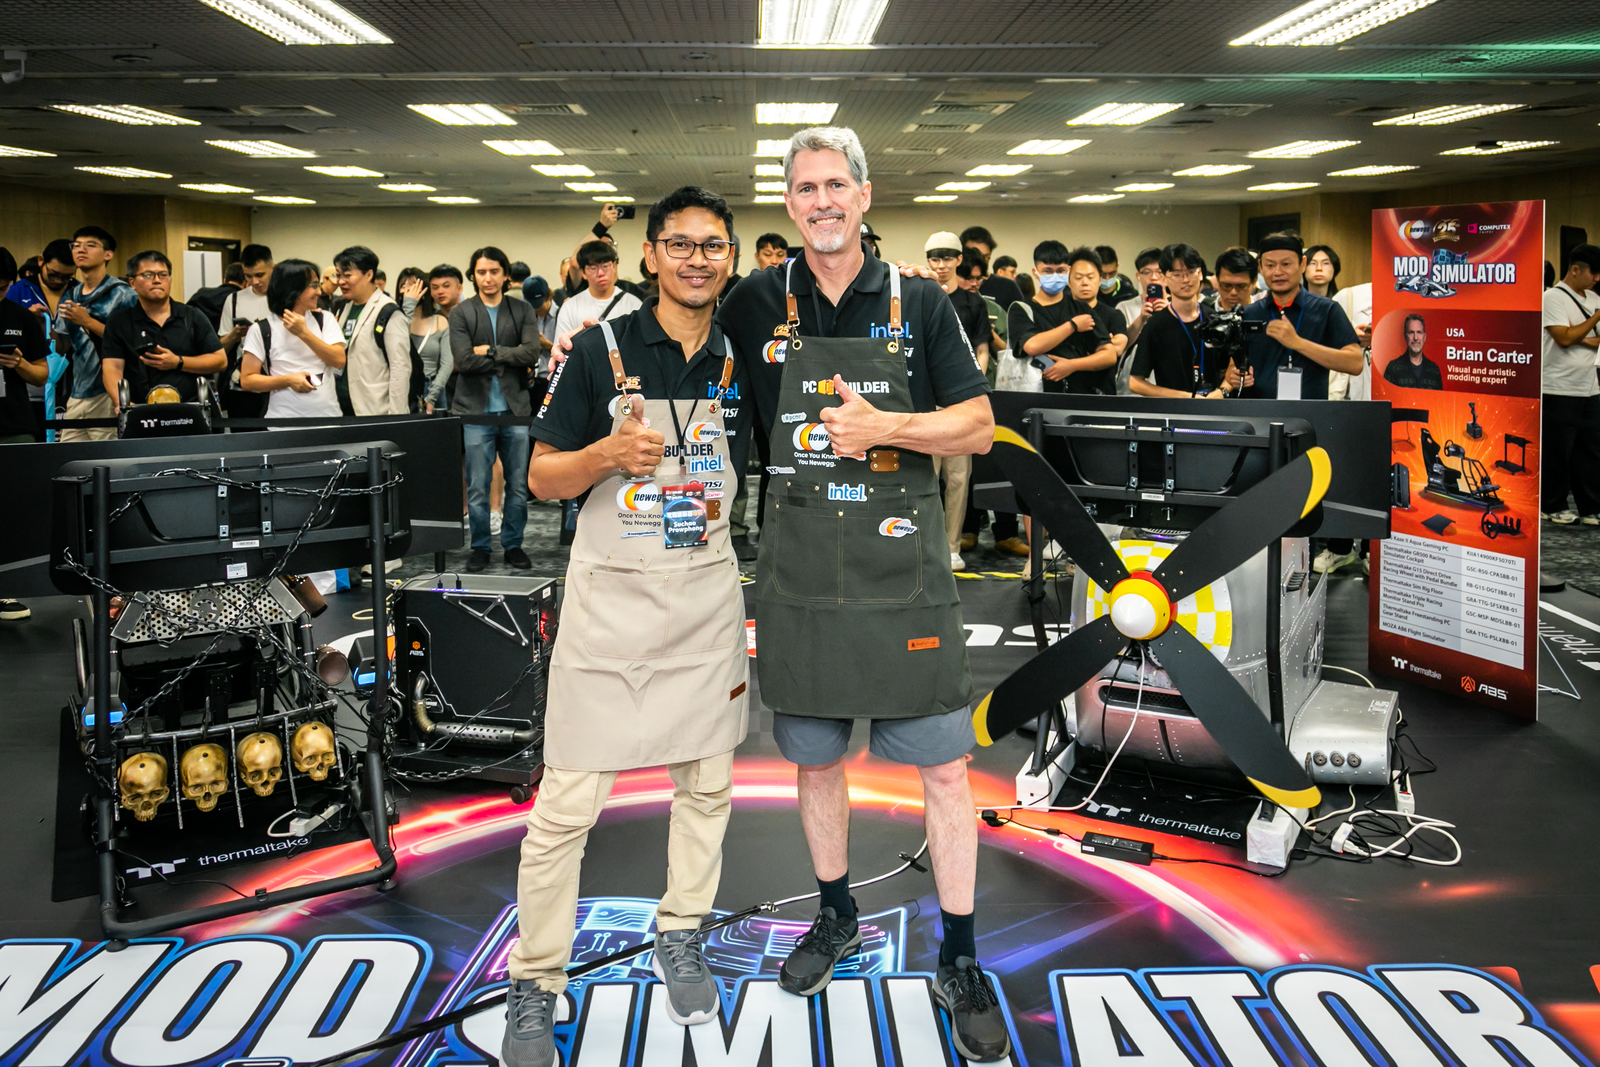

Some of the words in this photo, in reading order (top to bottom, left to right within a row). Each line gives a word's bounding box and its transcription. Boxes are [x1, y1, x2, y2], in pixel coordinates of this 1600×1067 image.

[1394, 256, 1429, 276] MOD
[1432, 263, 1516, 284] SIMULATOR
[1446, 328, 1465, 338] USA
[1446, 346, 1482, 362] Brian
[1487, 348, 1533, 364] Carter
[1447, 365, 1470, 374] Visual
[1472, 368, 1487, 376] and
[1488, 368, 1516, 377] artistic
[1447, 373, 1480, 384] modding
[1482, 376, 1507, 385] expert
[802, 380, 817, 394] PC
[835, 381, 890, 394] UILDER
[536, 405, 548, 420] PC
[808, 433, 830, 442] newe
[664, 444, 714, 458] BULDER
[1384, 544, 1412, 555] Thermaltake
[1413, 550, 1428, 558] GR500
[1429, 554, 1446, 563] Racing
[1422, 542, 1441, 550] Gaming
[1384, 550, 1406, 559] Simulator
[1406, 554, 1424, 564] Cockpit
[1383, 566, 1398, 574] Racing
[1400, 569, 1414, 578] Wheel
[1414, 572, 1426, 580] with
[1426, 576, 1440, 584] Pedal
[1440, 579, 1458, 588] Bundle
[1384, 560, 1412, 570] Thermaltake
[1423, 569, 1438, 578] Direct
[1438, 572, 1452, 580] Drive
[1383, 577, 1412, 588] Thermaltake
[1431, 587, 1444, 595] Floor
[1383, 587, 1412, 598] Thermaltake
[1412, 594, 1426, 602] Triple
[1426, 598, 1443, 607] Racing
[1383, 593, 1400, 602] Monitor
[1402, 598, 1416, 606] Stand
[1383, 604, 1412, 615] Thermaltake
[1412, 610, 1444, 625] Freestanding
[1382, 621, 1397, 630] MOZA
[1408, 628, 1422, 637] Flight
[1422, 632, 1446, 642] Simulator
[1410, 664, 1442, 680] thermaltake
[1478, 684, 1508, 700] ABS
[1139, 813, 1242, 840] thermaltake
[198, 837, 309, 866] thermaltake
[0, 937, 424, 1066] MOD
